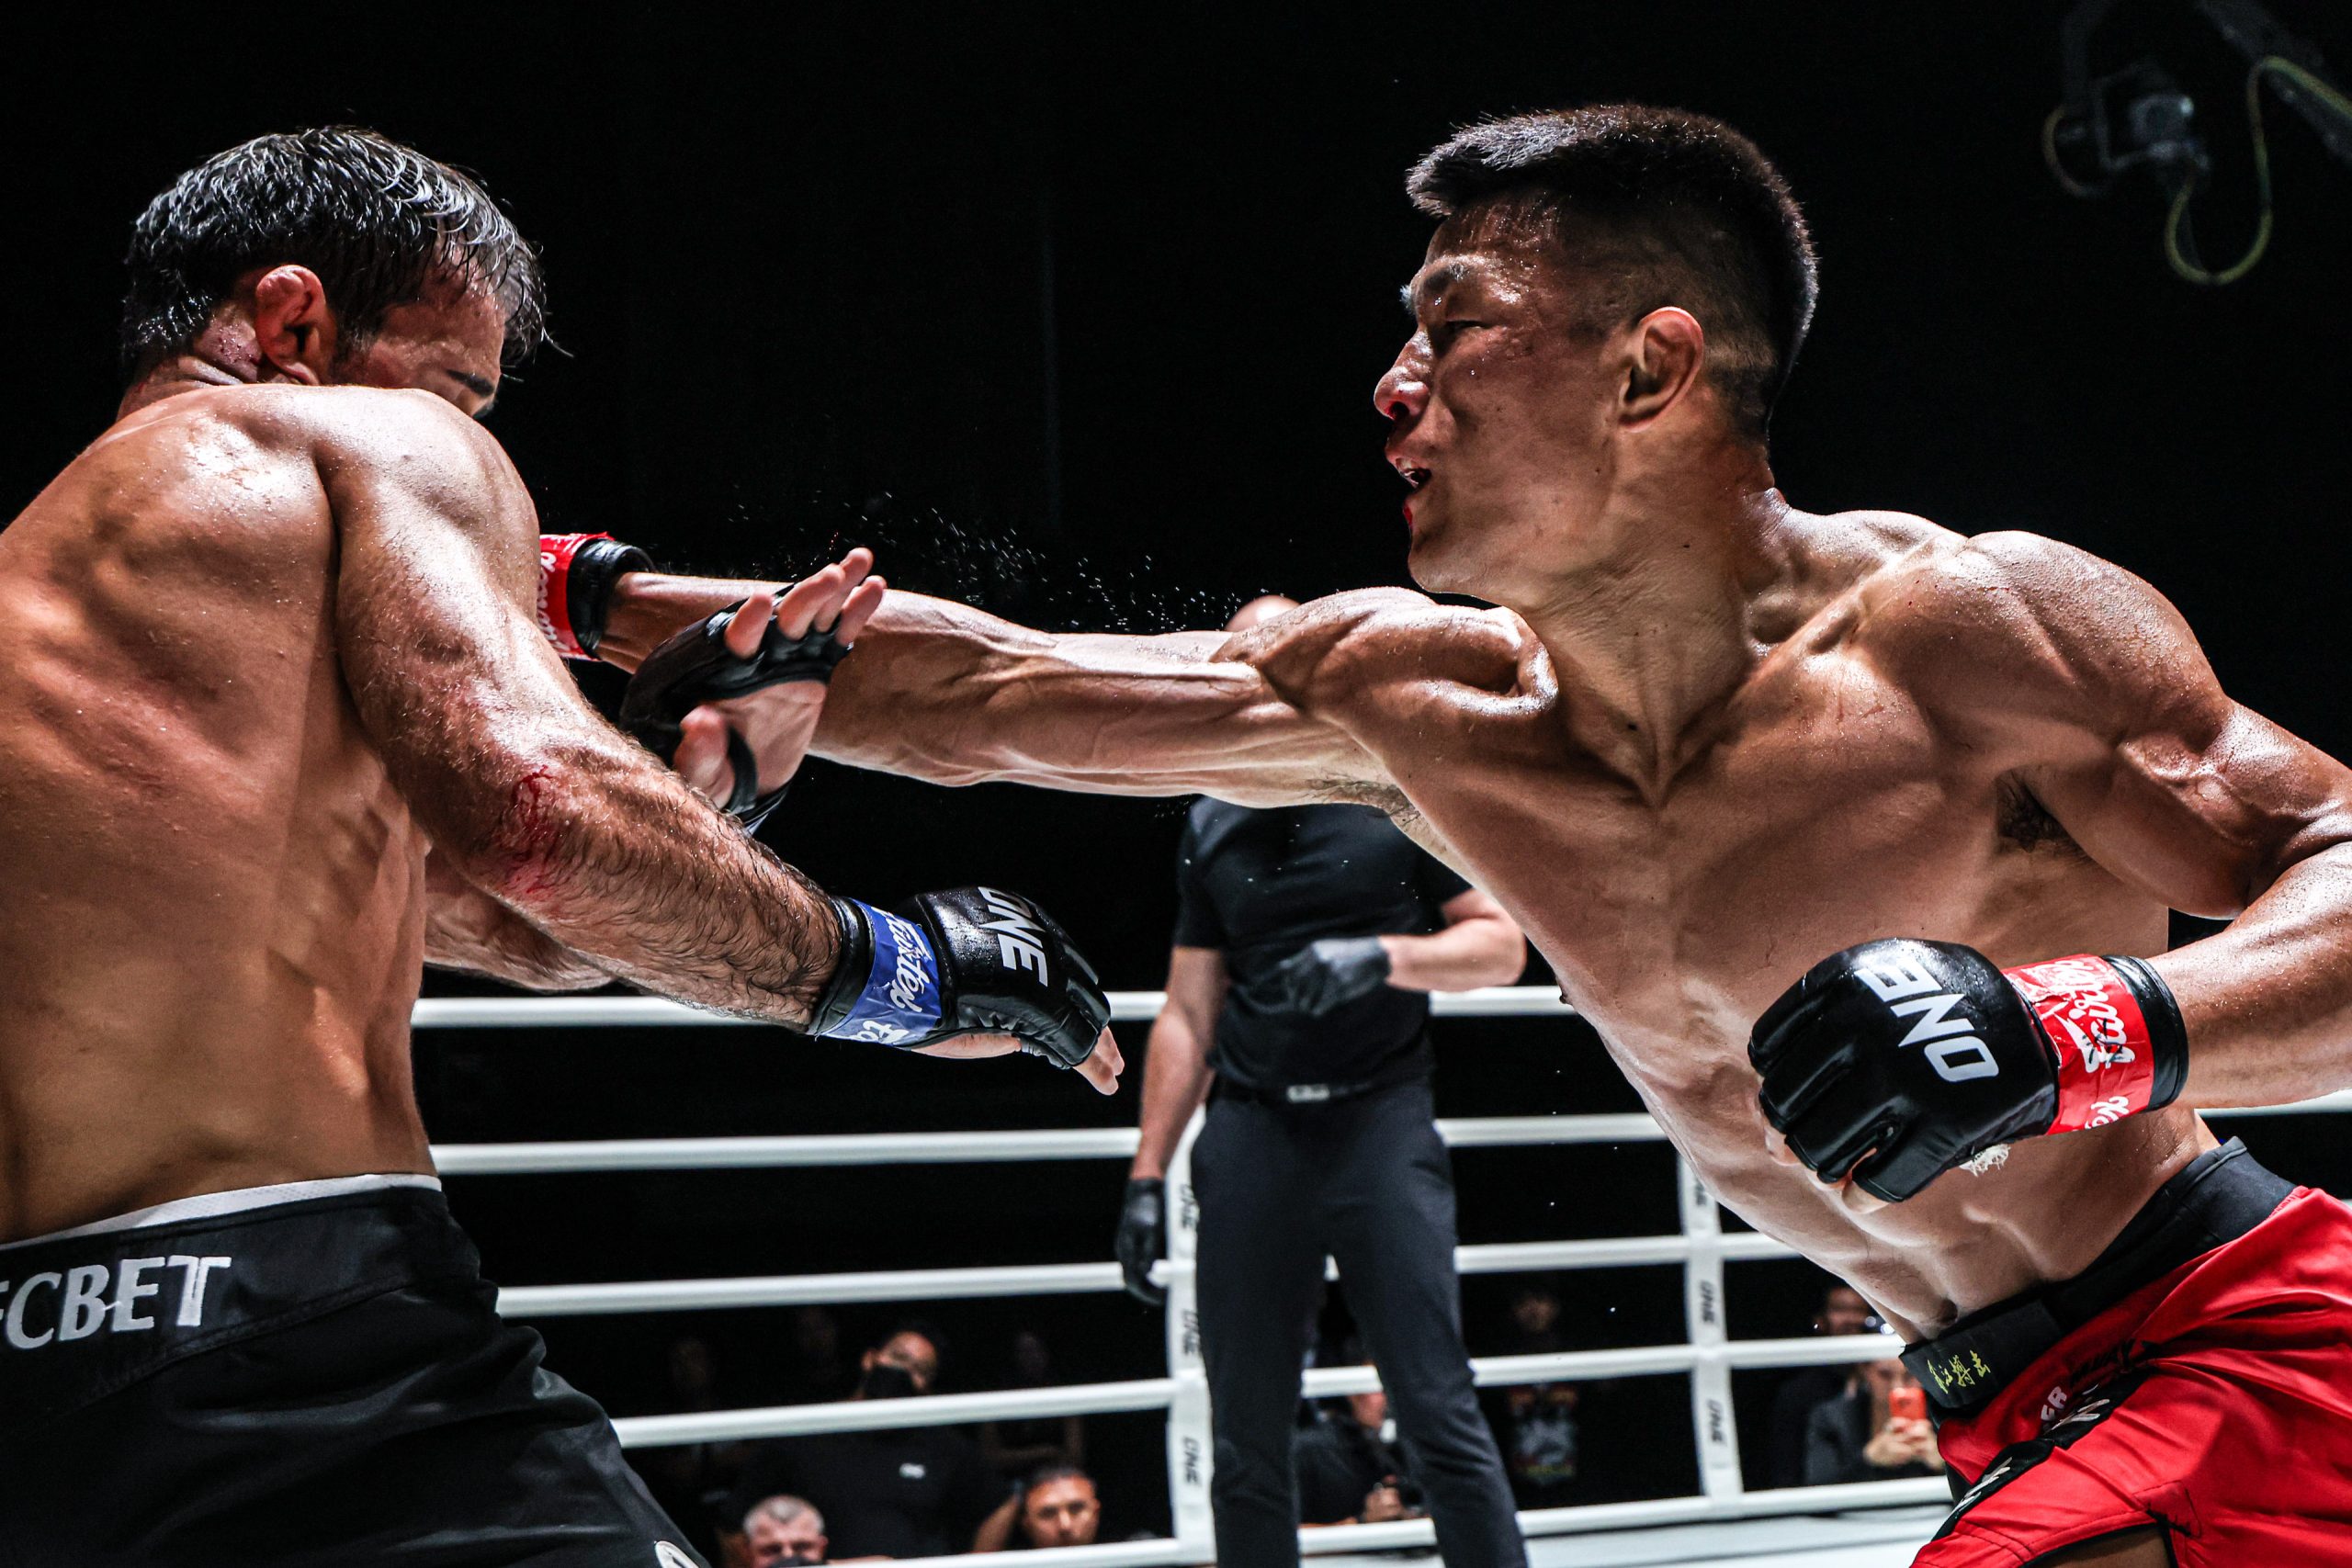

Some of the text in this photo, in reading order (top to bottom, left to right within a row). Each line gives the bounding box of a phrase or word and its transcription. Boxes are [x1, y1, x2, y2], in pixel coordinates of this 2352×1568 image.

[978, 886, 1048, 987] ONE
[1854, 957, 1999, 1082] ONE
[1182, 1436, 1201, 1486] ONE
